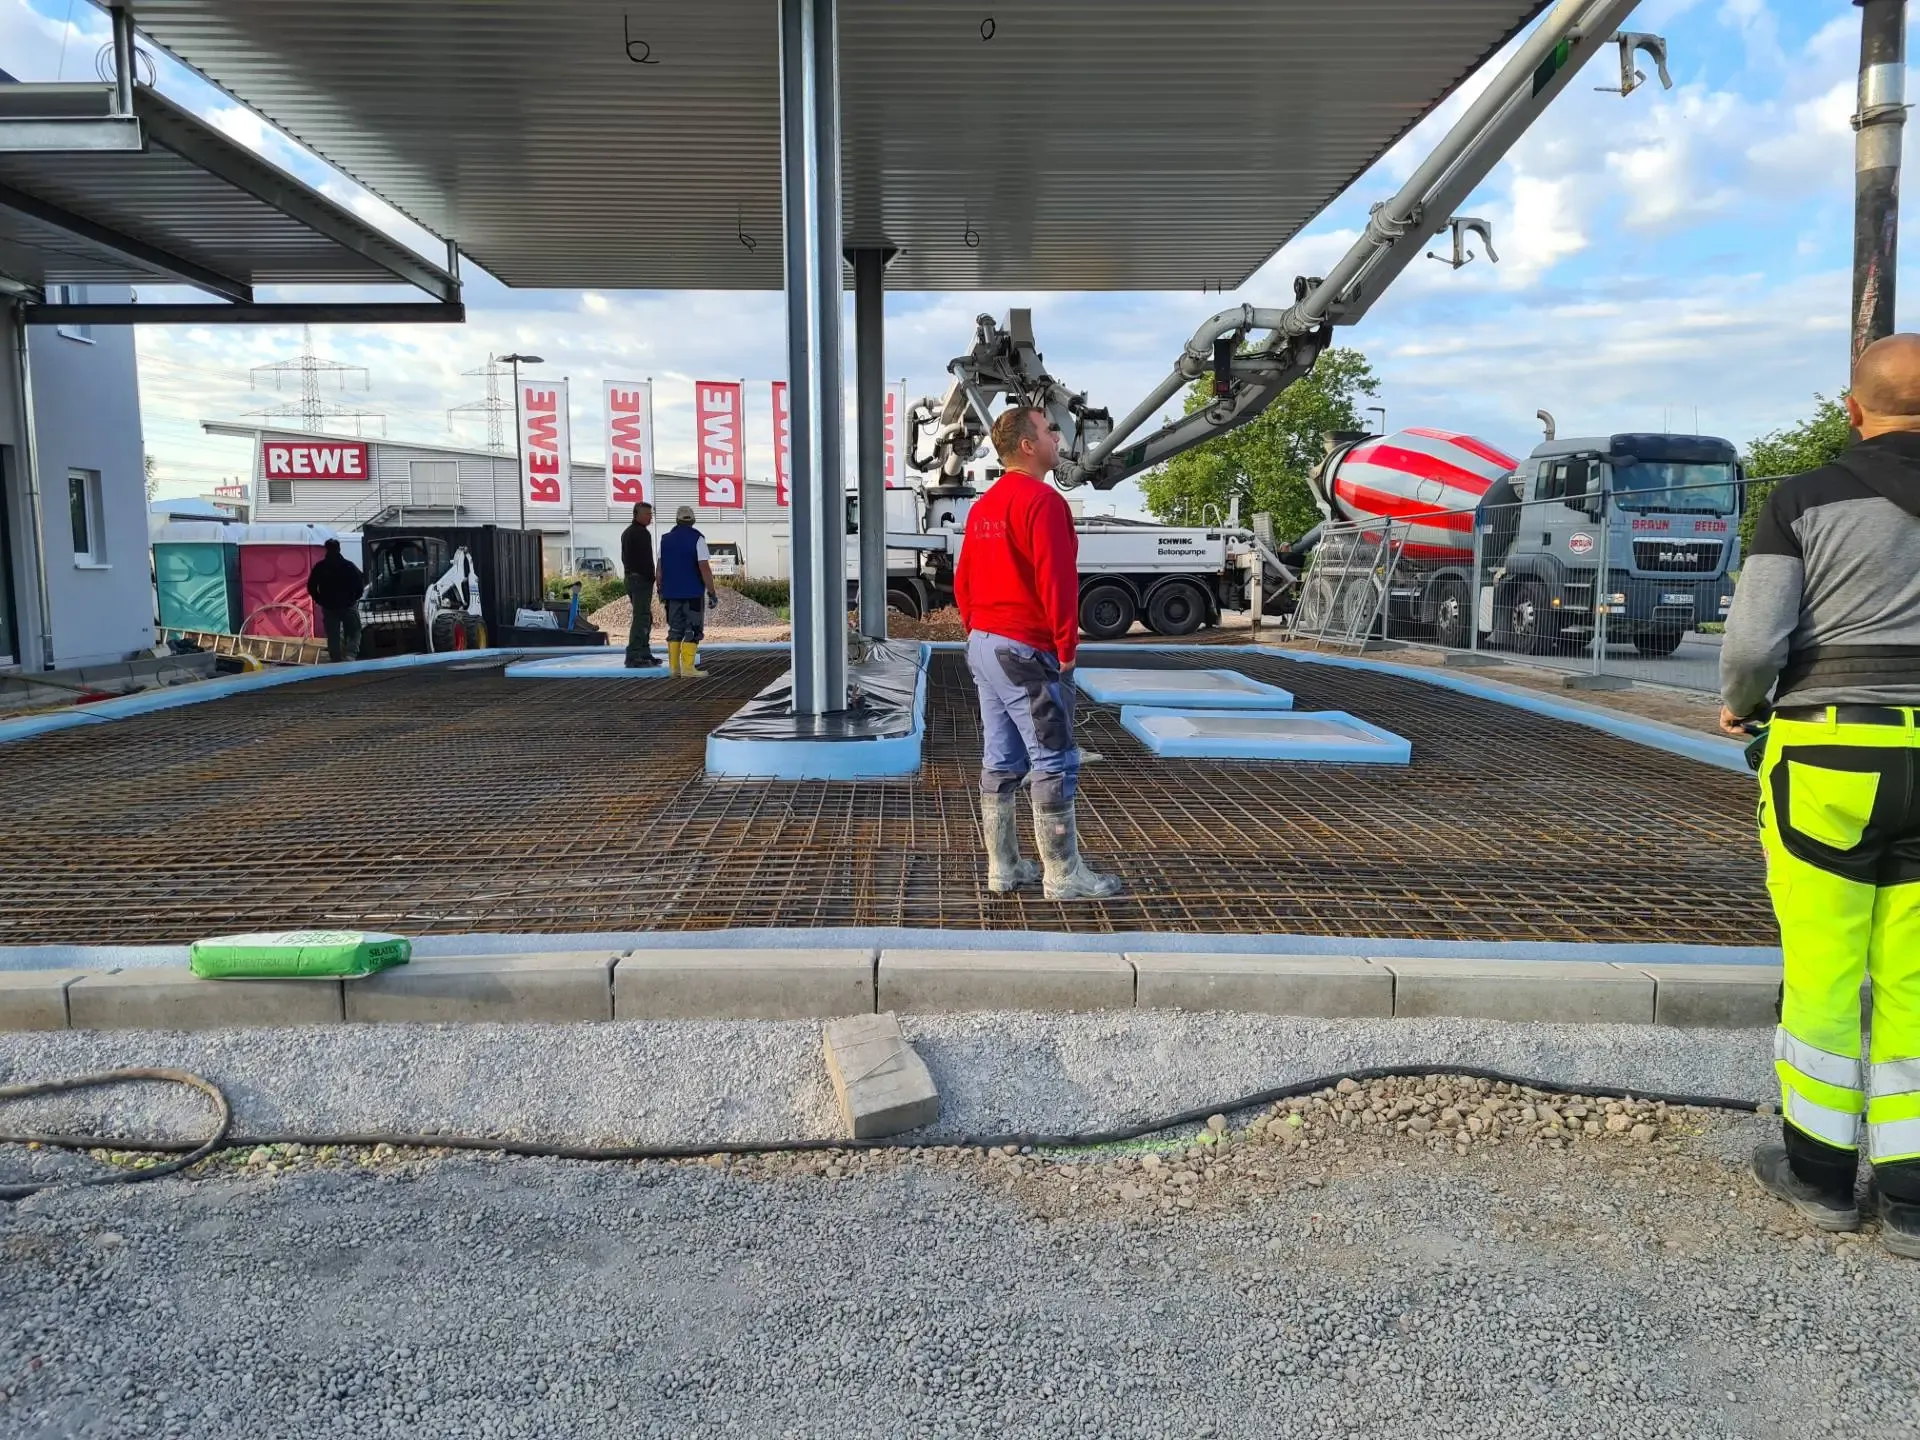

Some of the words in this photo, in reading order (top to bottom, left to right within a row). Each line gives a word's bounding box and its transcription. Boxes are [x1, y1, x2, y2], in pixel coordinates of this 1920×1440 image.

[268, 448, 362, 474] REWE
[1632, 519, 1670, 530] BRAUN
[1694, 520, 1728, 532] BETON
[1157, 548, 1207, 557] Betonpumpe
[1659, 552, 1698, 562] MAN
